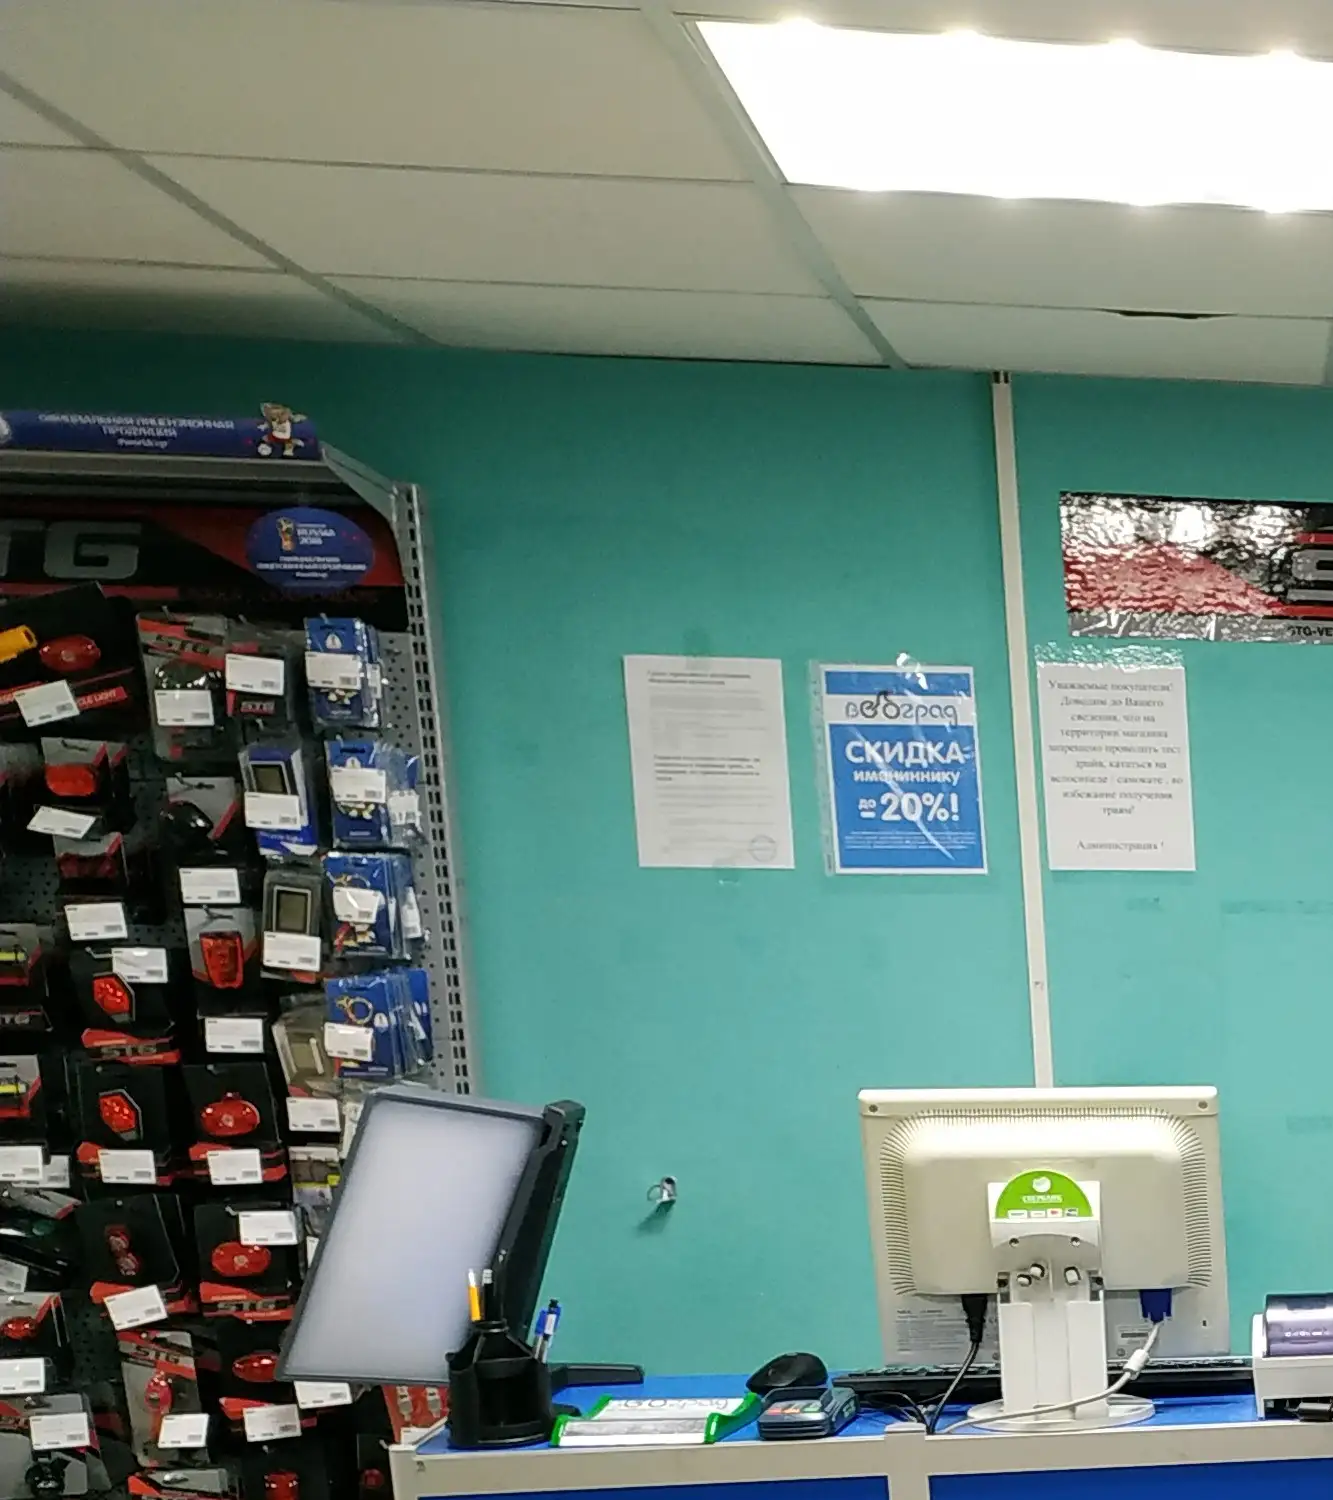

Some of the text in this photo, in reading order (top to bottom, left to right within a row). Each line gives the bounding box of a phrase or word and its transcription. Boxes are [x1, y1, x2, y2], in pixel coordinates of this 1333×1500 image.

[1048, 679, 1174, 694] Уважаемые покупатели!
[1060, 695, 1164, 708] Доводим до Вашего
[1071, 712, 1156, 723] сведения, что на
[1060, 728, 1169, 740] территории магазина
[845, 740, 964, 768] СКИДКА
[1048, 744, 1182, 755] запрещено проводить тест
[1109, 760, 1153, 769] кататься
[1155, 761, 1167, 769] на
[853, 769, 961, 786] имениннику
[1050, 776, 1108, 785] велосипеде
[1116, 776, 1163, 785] самокате
[1171, 777, 1184, 785] во
[1062, 790, 1173, 802] избежание получения
[858, 798, 877, 812] до
[1076, 839, 1158, 851] Администрация
[131, 1344, 184, 1364] STG
